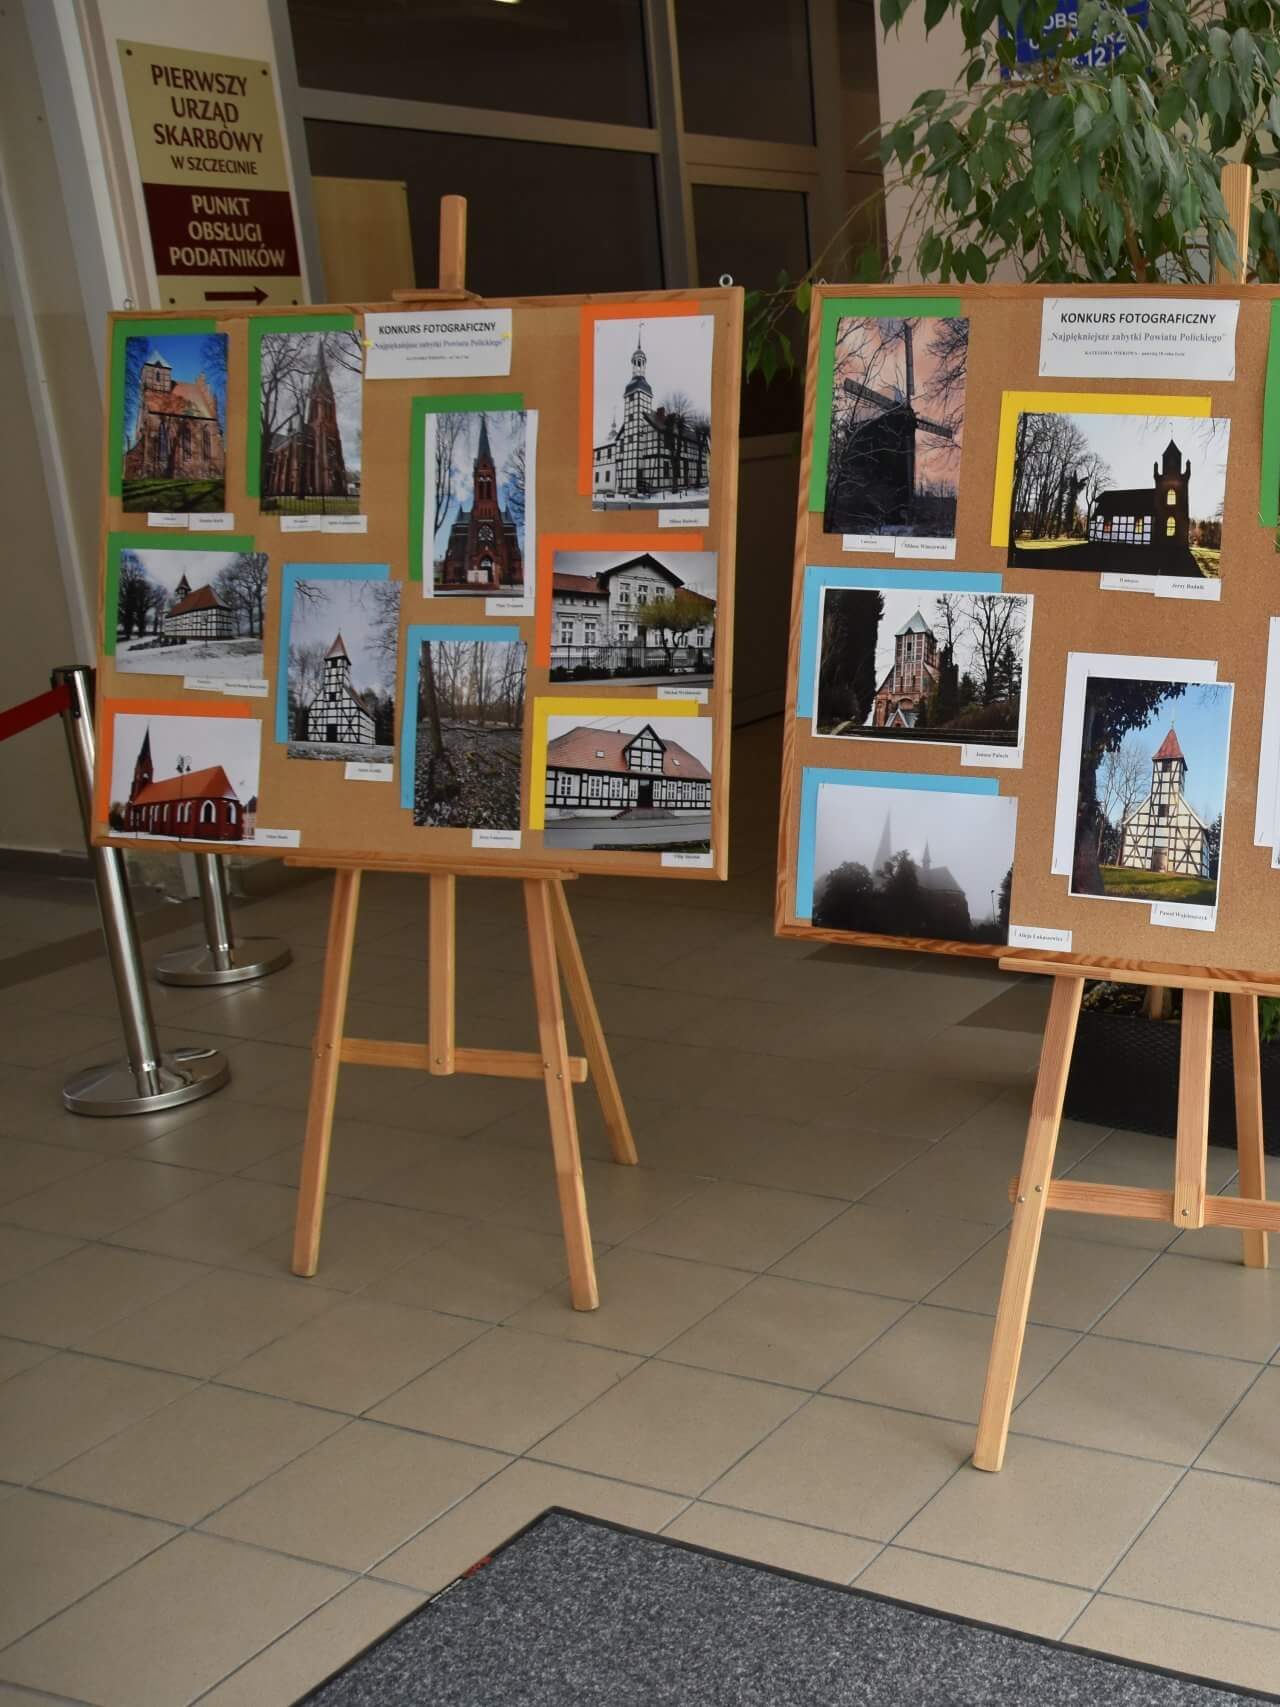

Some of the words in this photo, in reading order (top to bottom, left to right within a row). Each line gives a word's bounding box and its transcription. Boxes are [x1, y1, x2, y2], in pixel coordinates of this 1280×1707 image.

[151, 64, 248, 97] PIERWSZY
[171, 96, 239, 128] URZĄD
[153, 123, 263, 152] SKARBOWY
[171, 155, 184, 170] W
[187, 157, 258, 175] SZCZECINIE
[191, 194, 250, 217] PUNKT
[188, 221, 262, 242] OBSŁUGI
[169, 243, 285, 267] PODATNIKÓW
[379, 323, 421, 335] KONKURS
[423, 321, 496, 333] FOTOGRAFICZNY
[1060, 312, 1116, 324] KONKURS
[1119, 313, 1216, 324] FOTOGRAFICZNY
[1111, 332, 1142, 343] zabytki
[1144, 332, 1177, 342] Powiatu
